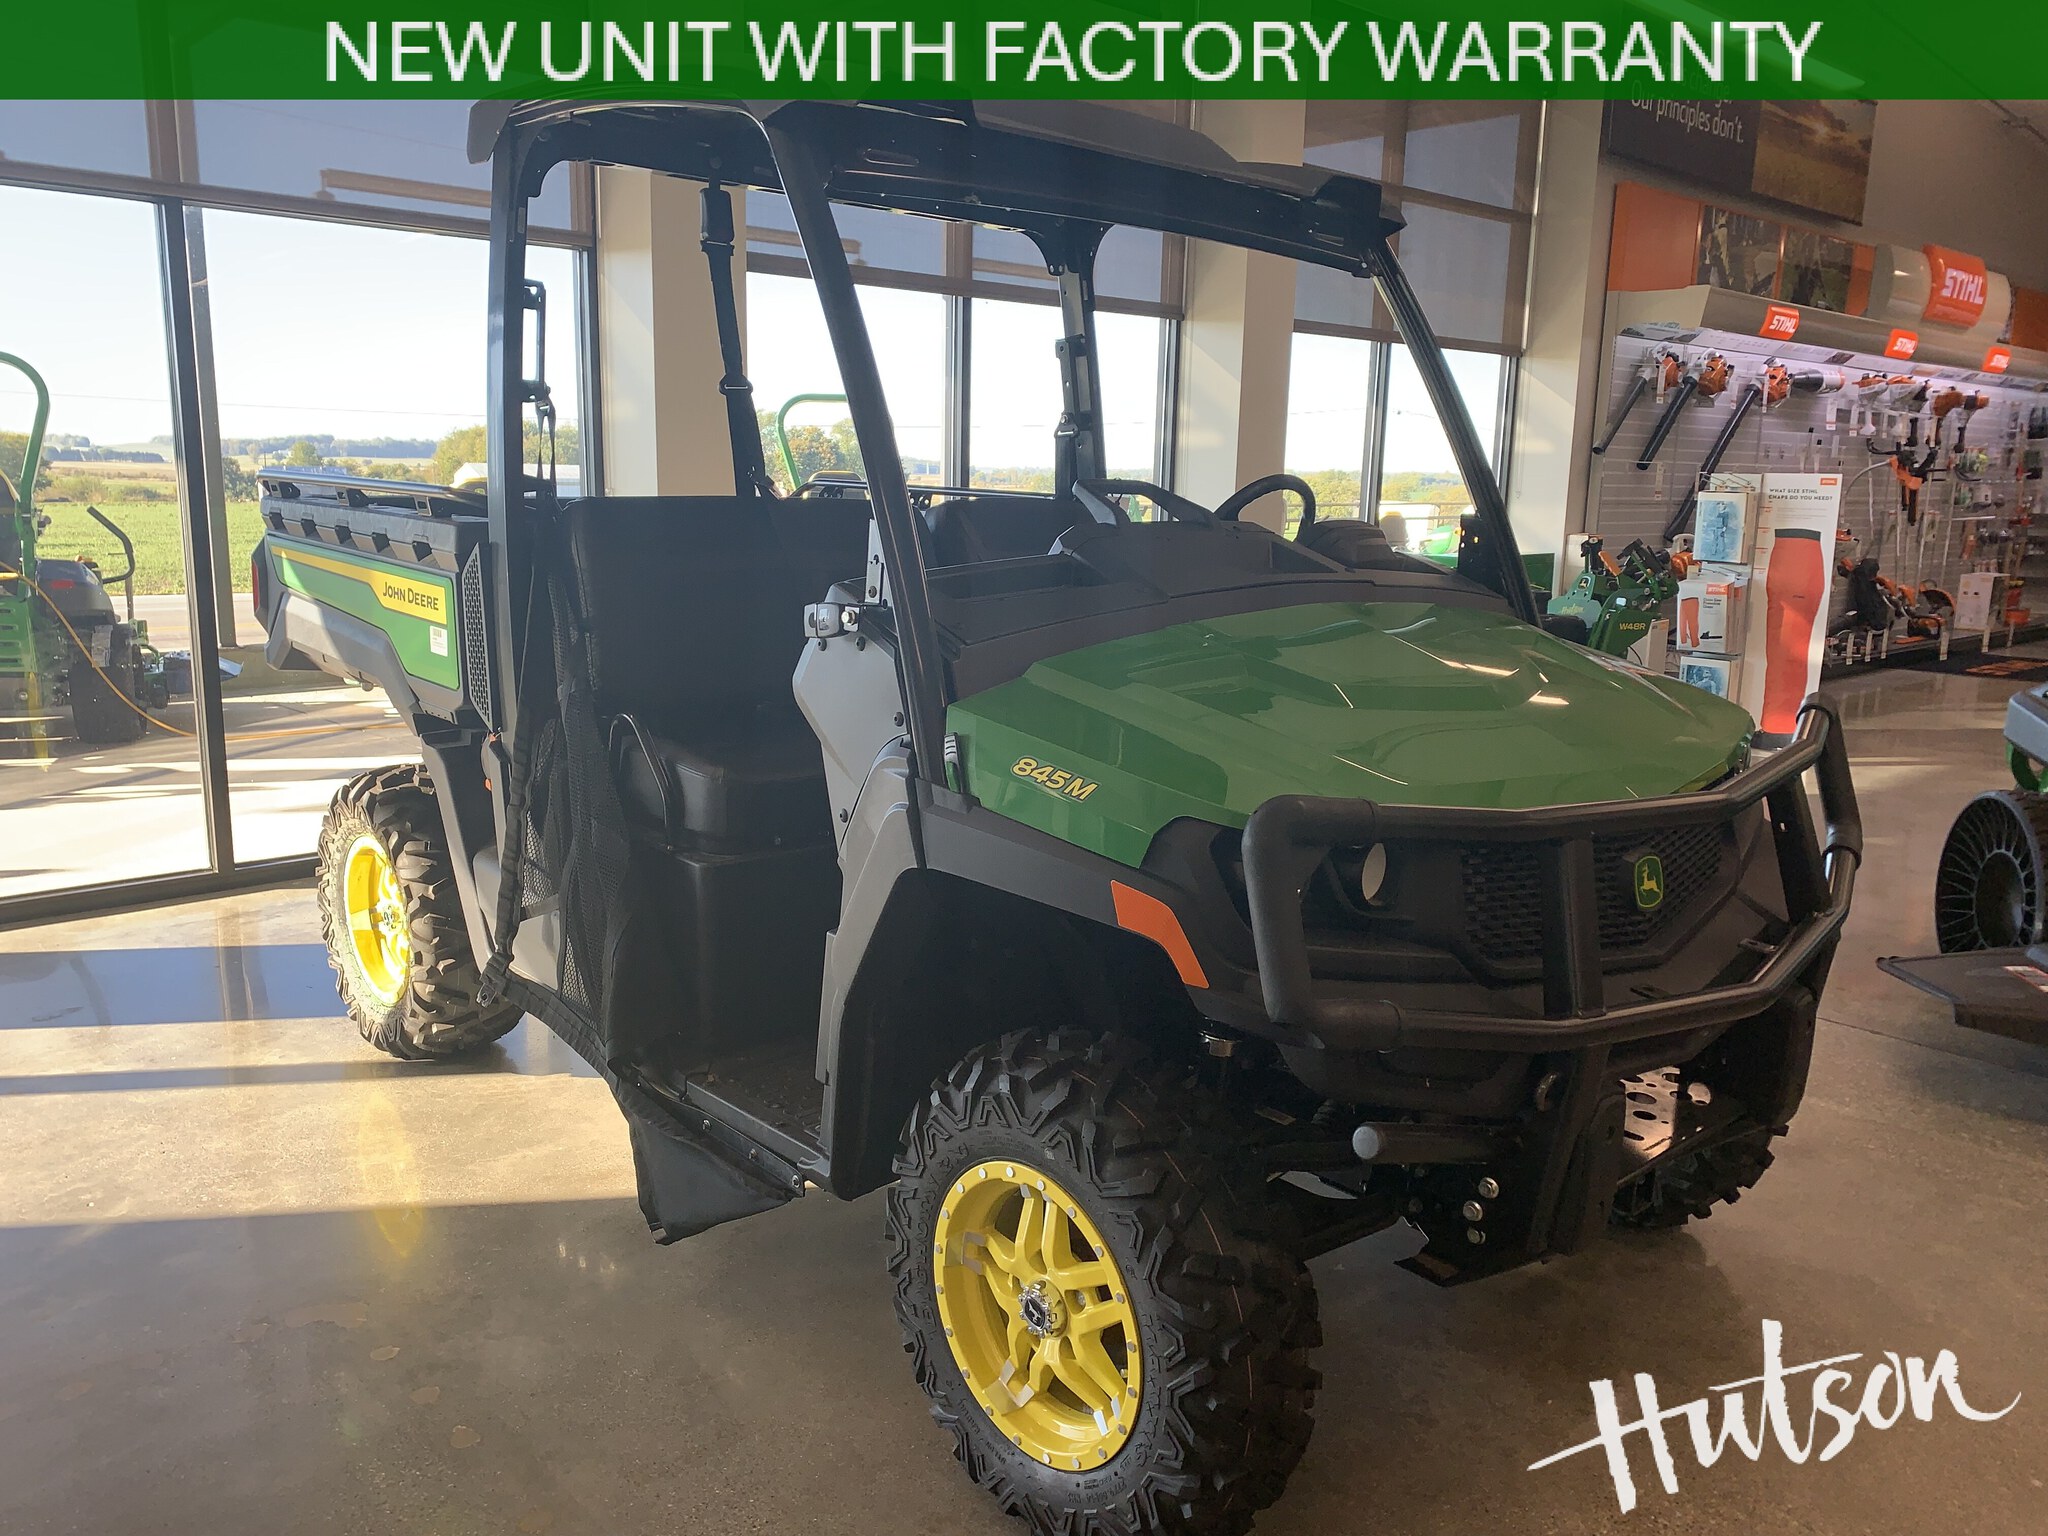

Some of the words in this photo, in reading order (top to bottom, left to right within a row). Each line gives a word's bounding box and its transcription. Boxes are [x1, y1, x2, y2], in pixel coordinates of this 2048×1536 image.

[1656, 95, 1711, 132] principles
[1712, 110, 1744, 143] don't.
[1941, 268, 1985, 305] STIHL
[1768, 313, 1797, 333] STIHL
[1893, 336, 1918, 353] STIHL
[383, 582, 405, 602] JOHN
[407, 588, 439, 611] DEERE
[1012, 757, 1099, 801] 845M
